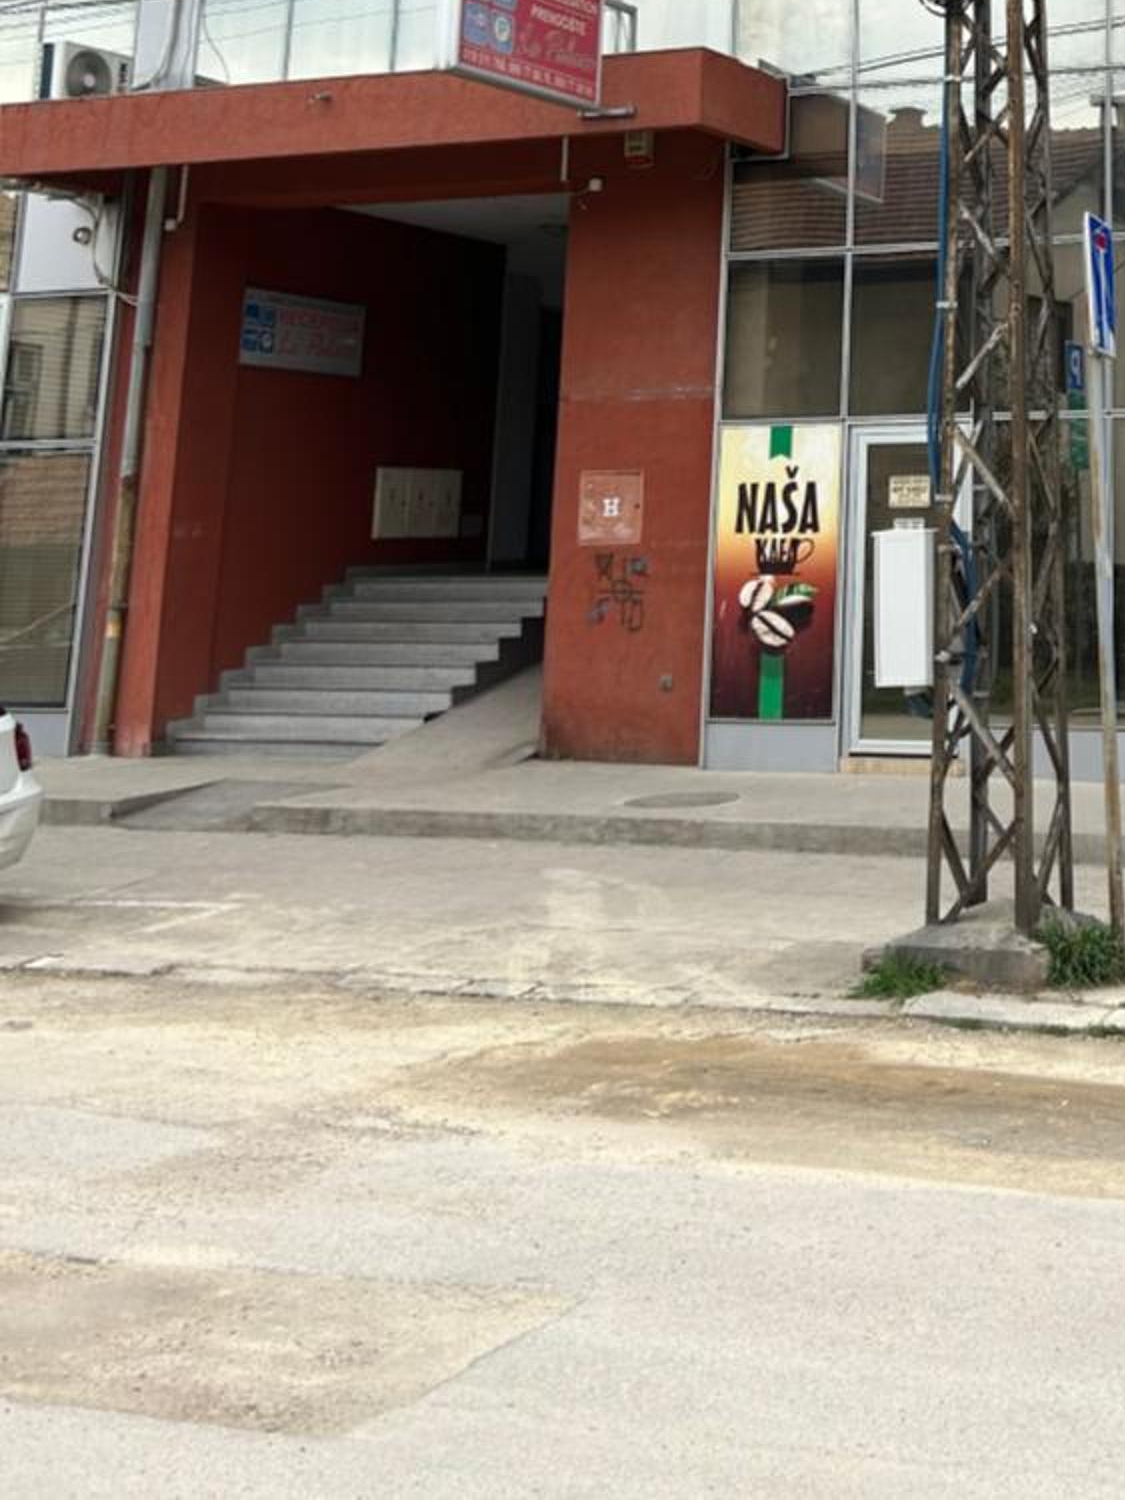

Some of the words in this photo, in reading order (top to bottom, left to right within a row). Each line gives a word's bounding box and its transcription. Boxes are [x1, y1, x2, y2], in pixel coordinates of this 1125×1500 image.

[602, 497, 621, 517] H
[735, 465, 820, 534] NAŠA
[755, 537, 802, 565] KAFA
